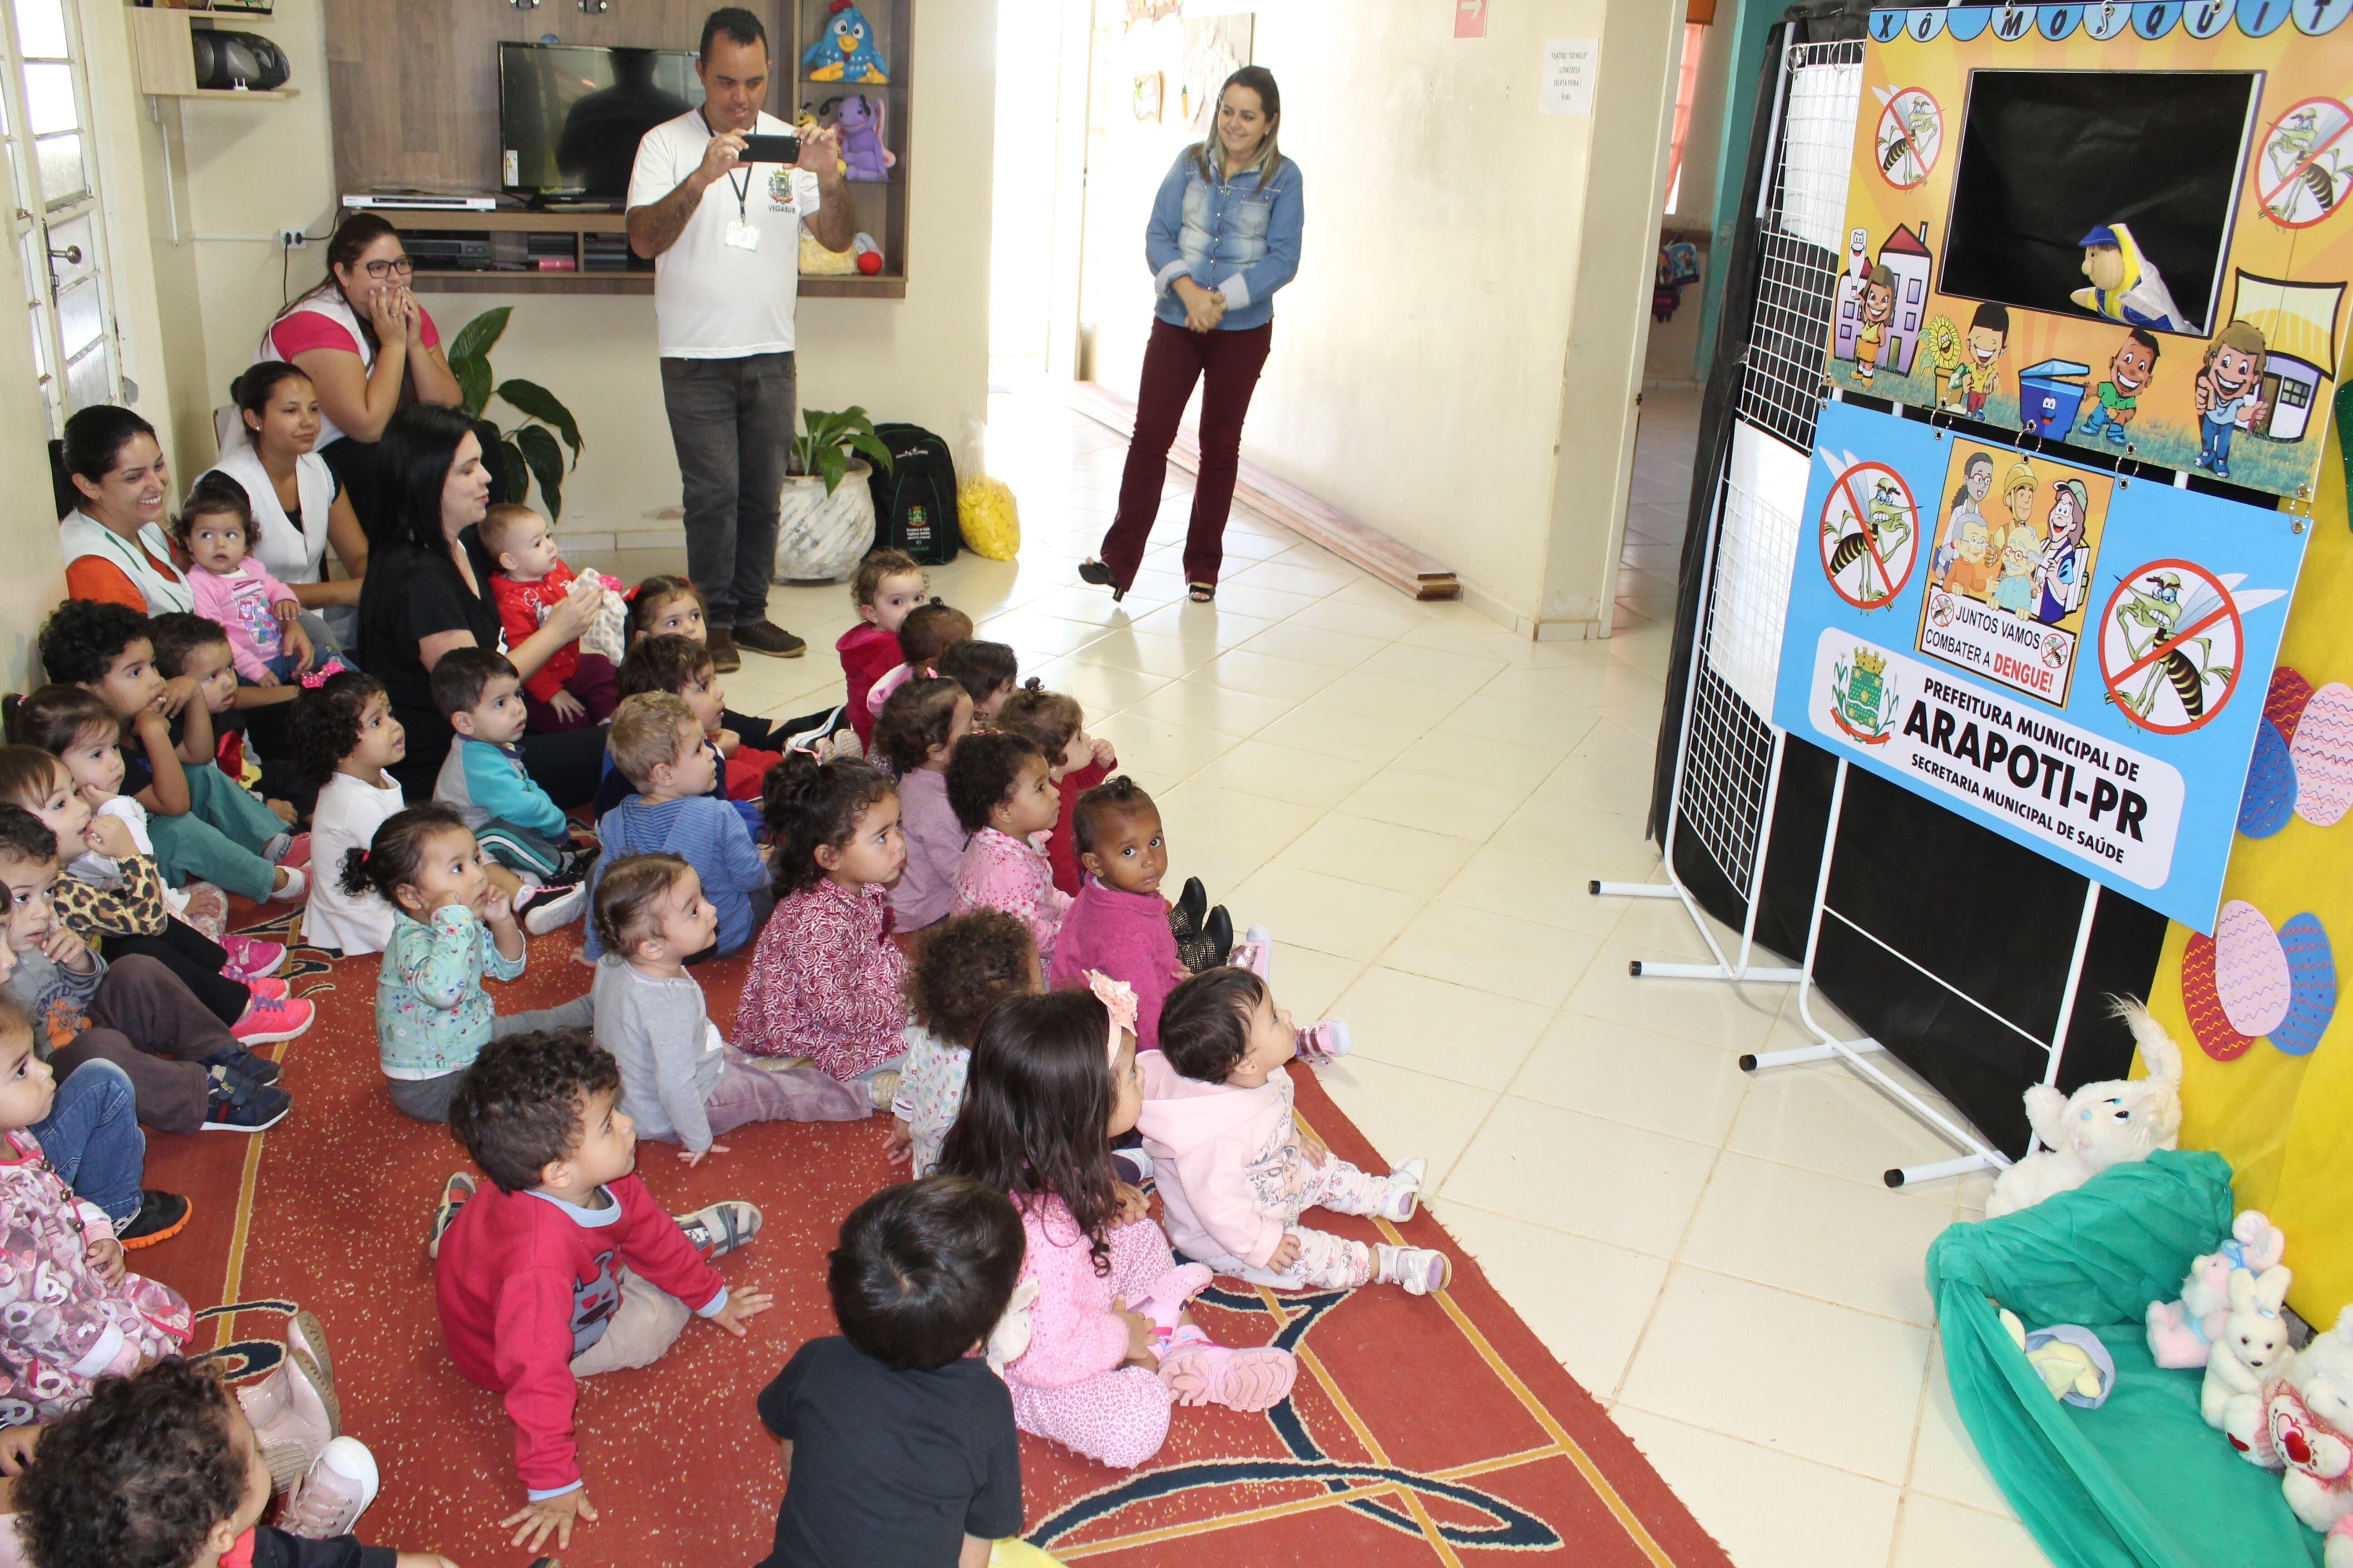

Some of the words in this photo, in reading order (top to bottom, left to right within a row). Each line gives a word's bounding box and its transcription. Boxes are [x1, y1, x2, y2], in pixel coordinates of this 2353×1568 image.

[768, 205, 796, 213] VIGIASUS
[1926, 629, 1982, 664] COMBATER
[1982, 651, 1990, 667] A
[1993, 653, 2054, 694] DENGUE!
[1956, 606, 1998, 634] JUNTOS
[2002, 621, 2041, 650] VAMOS
[1903, 699, 2147, 843] ARAPOTI-PR
[1924, 677, 2012, 730] PREFEITURA
[2016, 716, 2110, 771] MUNICIPAL
[2115, 756, 2139, 782] DE
[1911, 754, 1979, 796] SECRETARIA
[1982, 787, 2053, 831] MUNICIPAL
[2056, 821, 2075, 840] DE
[2077, 830, 2124, 863] SAÚDE
